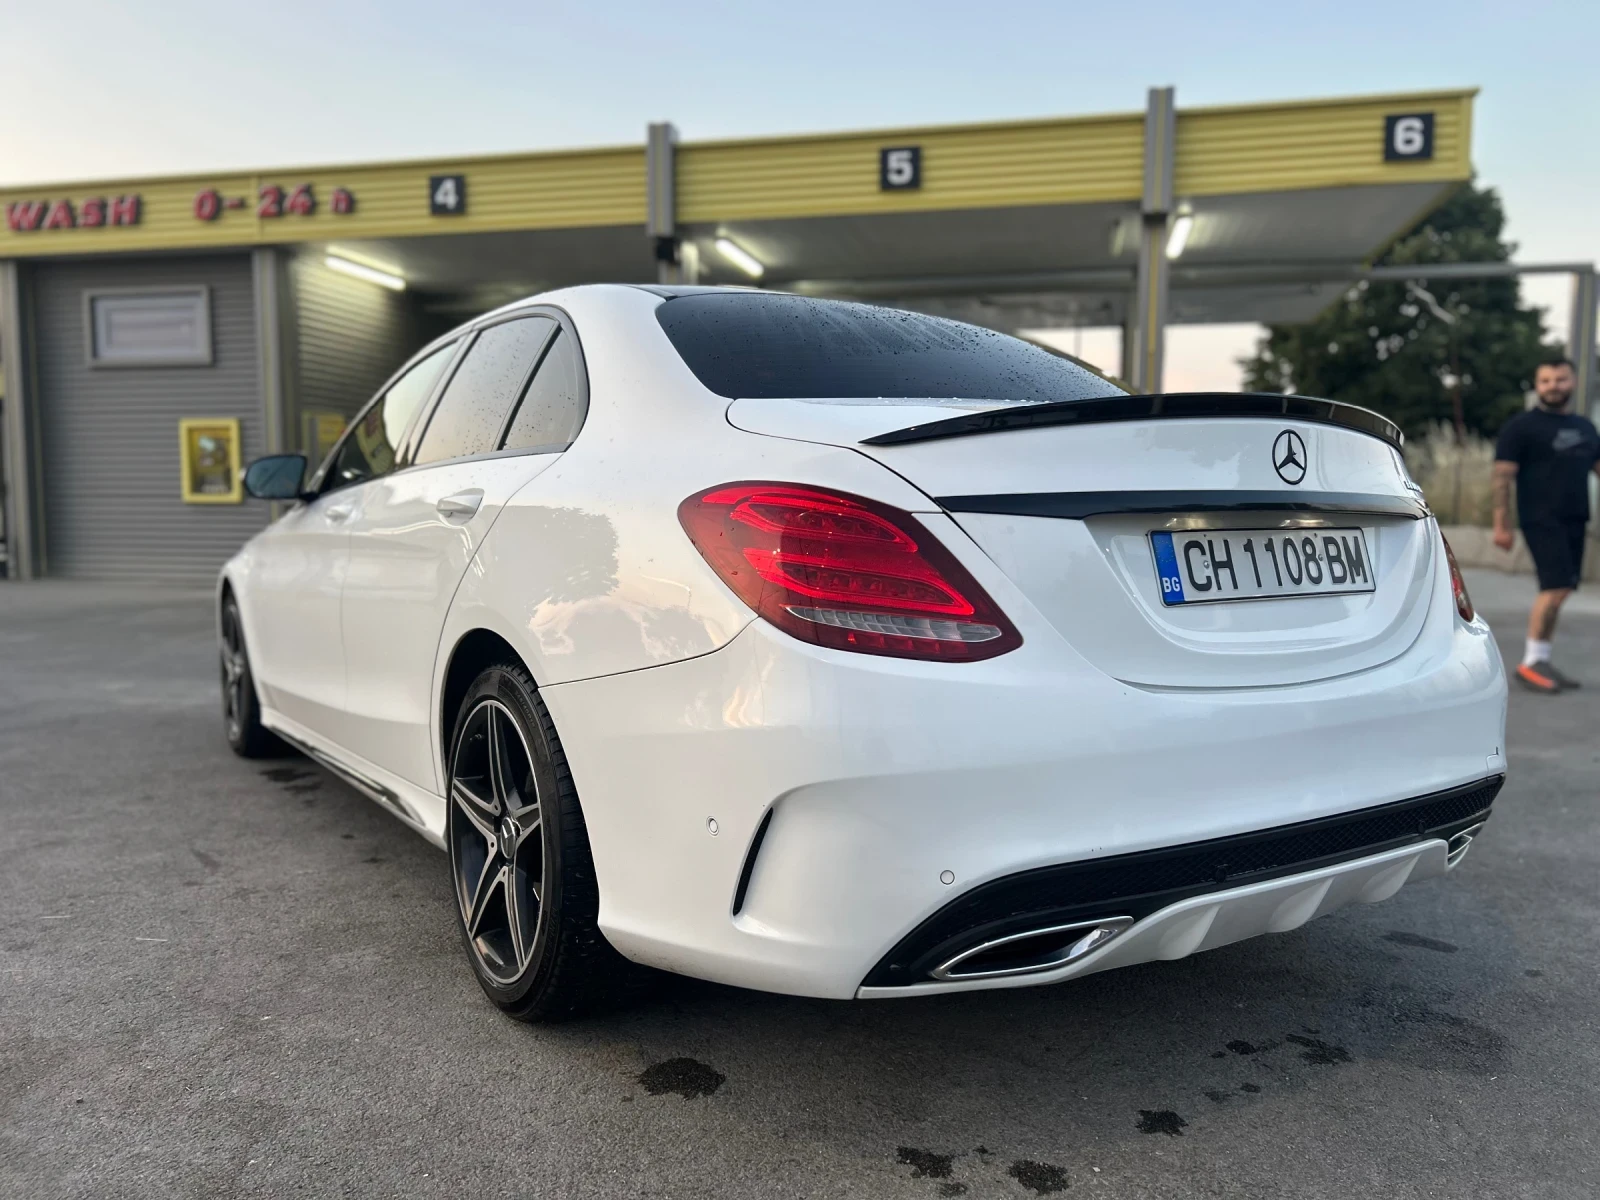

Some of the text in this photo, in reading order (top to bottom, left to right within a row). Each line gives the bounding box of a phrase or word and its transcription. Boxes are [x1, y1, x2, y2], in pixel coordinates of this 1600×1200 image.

[1393, 116, 1425, 155] 6
[887, 149, 914, 186] 5
[5, 192, 142, 231] WASH
[433, 178, 460, 210] 4
[1161, 576, 1181, 593] BG
